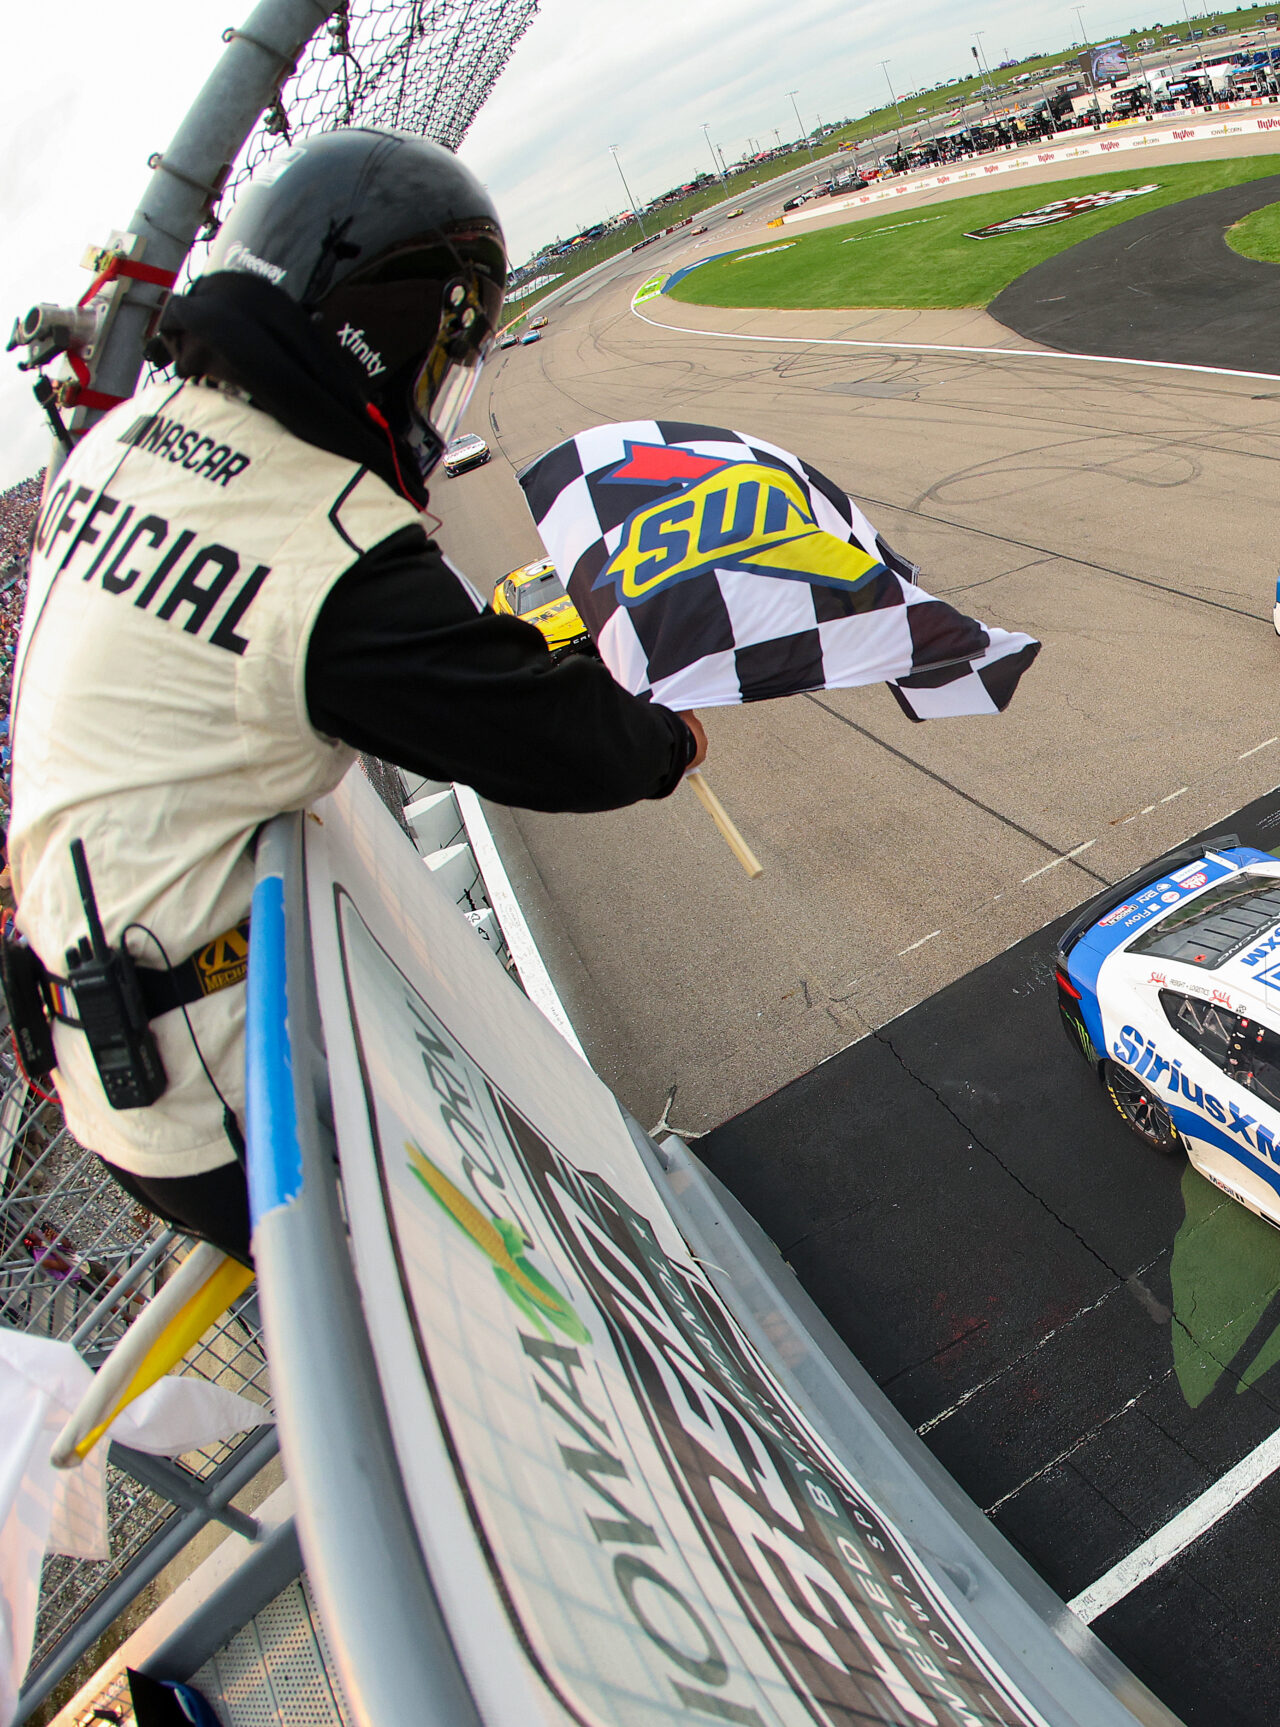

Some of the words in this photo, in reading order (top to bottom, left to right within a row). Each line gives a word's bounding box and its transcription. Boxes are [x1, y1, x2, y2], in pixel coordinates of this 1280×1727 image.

[336, 322, 387, 378] xfinity
[140, 415, 251, 488] NASCAR
[36, 479, 272, 656] OFFICIAL
[632, 480, 816, 589] SUN
[1124, 910, 1152, 928] Flow
[1216, 920, 1272, 967] RACING
[405, 998, 535, 1251] CORN
[516, 1326, 768, 1727] IOWA
[837, 1535, 984, 1727] WERED
[891, 1573, 963, 1666] IOWA
